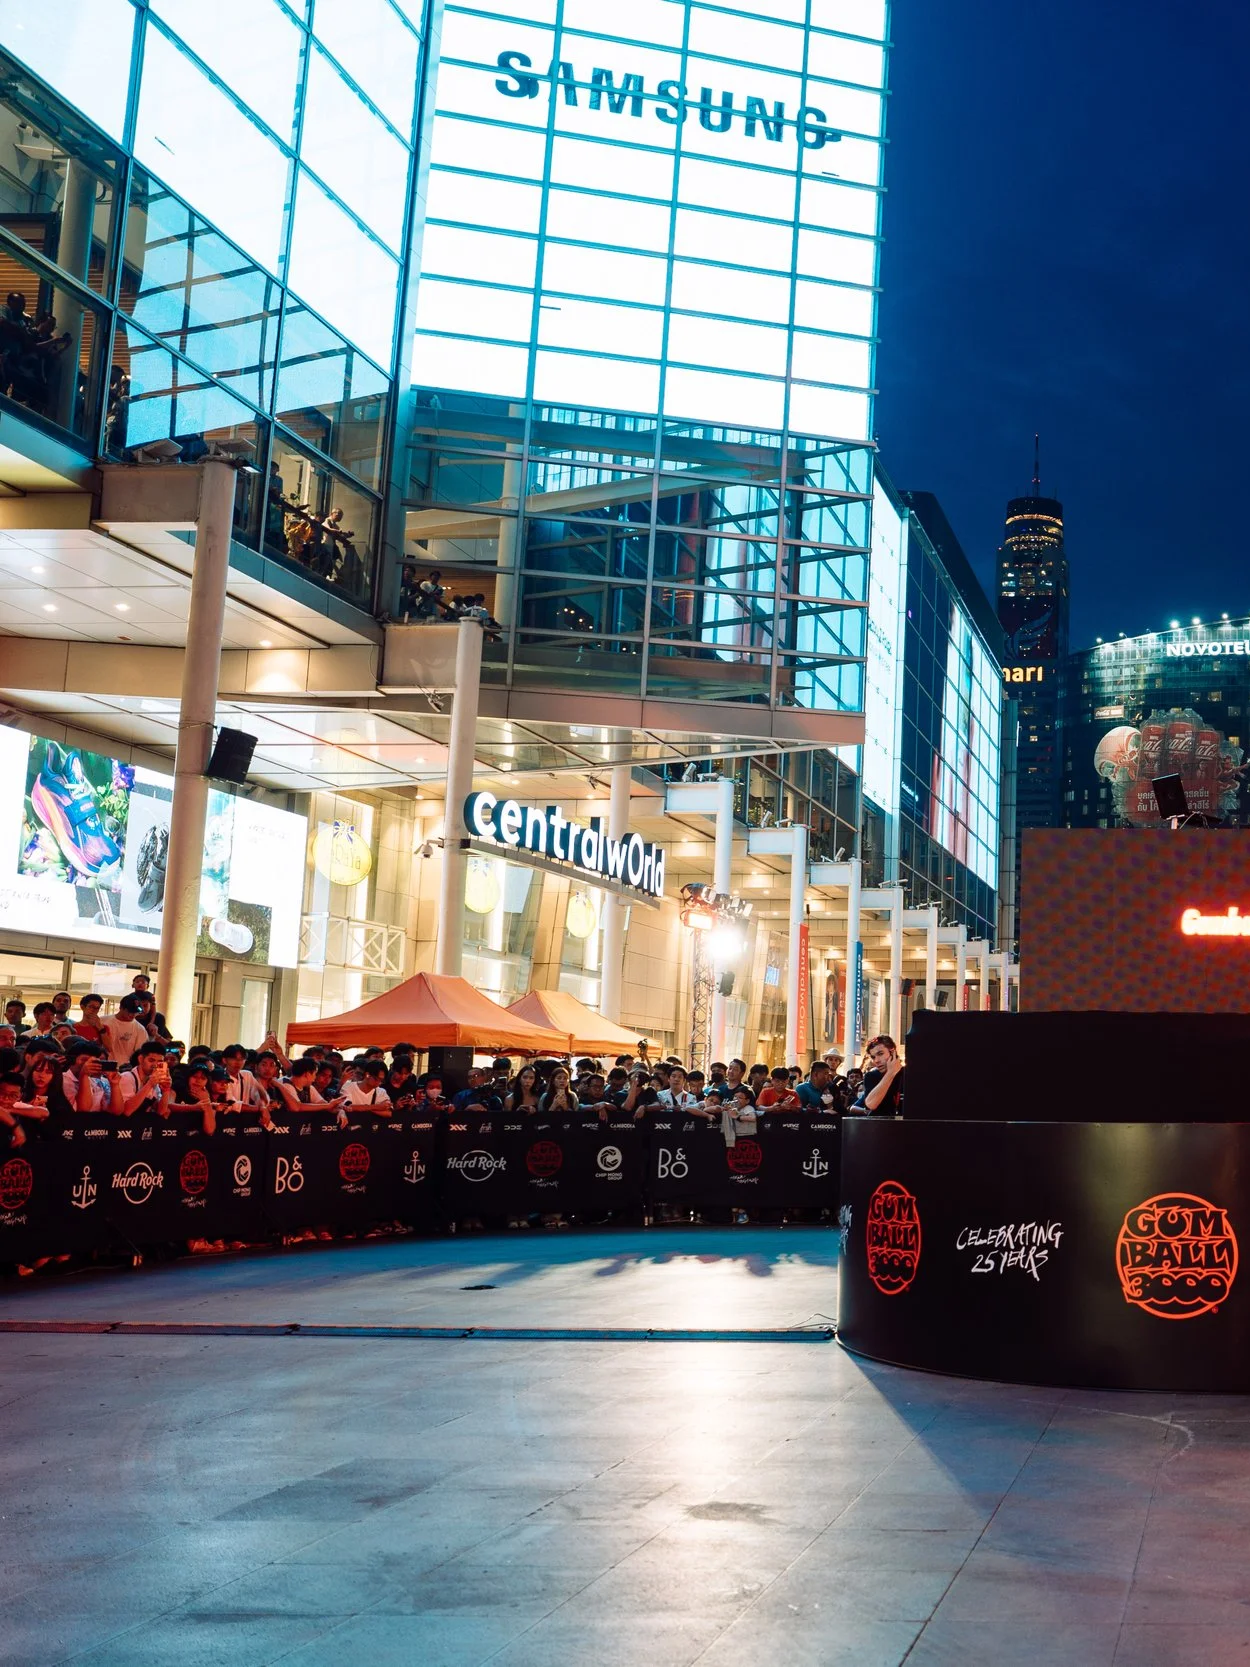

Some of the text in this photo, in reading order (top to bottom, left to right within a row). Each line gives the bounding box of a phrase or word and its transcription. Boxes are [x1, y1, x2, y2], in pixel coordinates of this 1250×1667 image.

[494, 50, 840, 150] SAMSUNG
[111, 1171, 164, 1189] Hard Rock
[447, 1157, 507, 1170] Hard Rock
[955, 1219, 1064, 1251] CELEBRATING
[1126, 1205, 1228, 1239] GUM
[970, 1246, 1049, 1282] 25 YEARS
[1121, 1237, 1231, 1272] BALL
